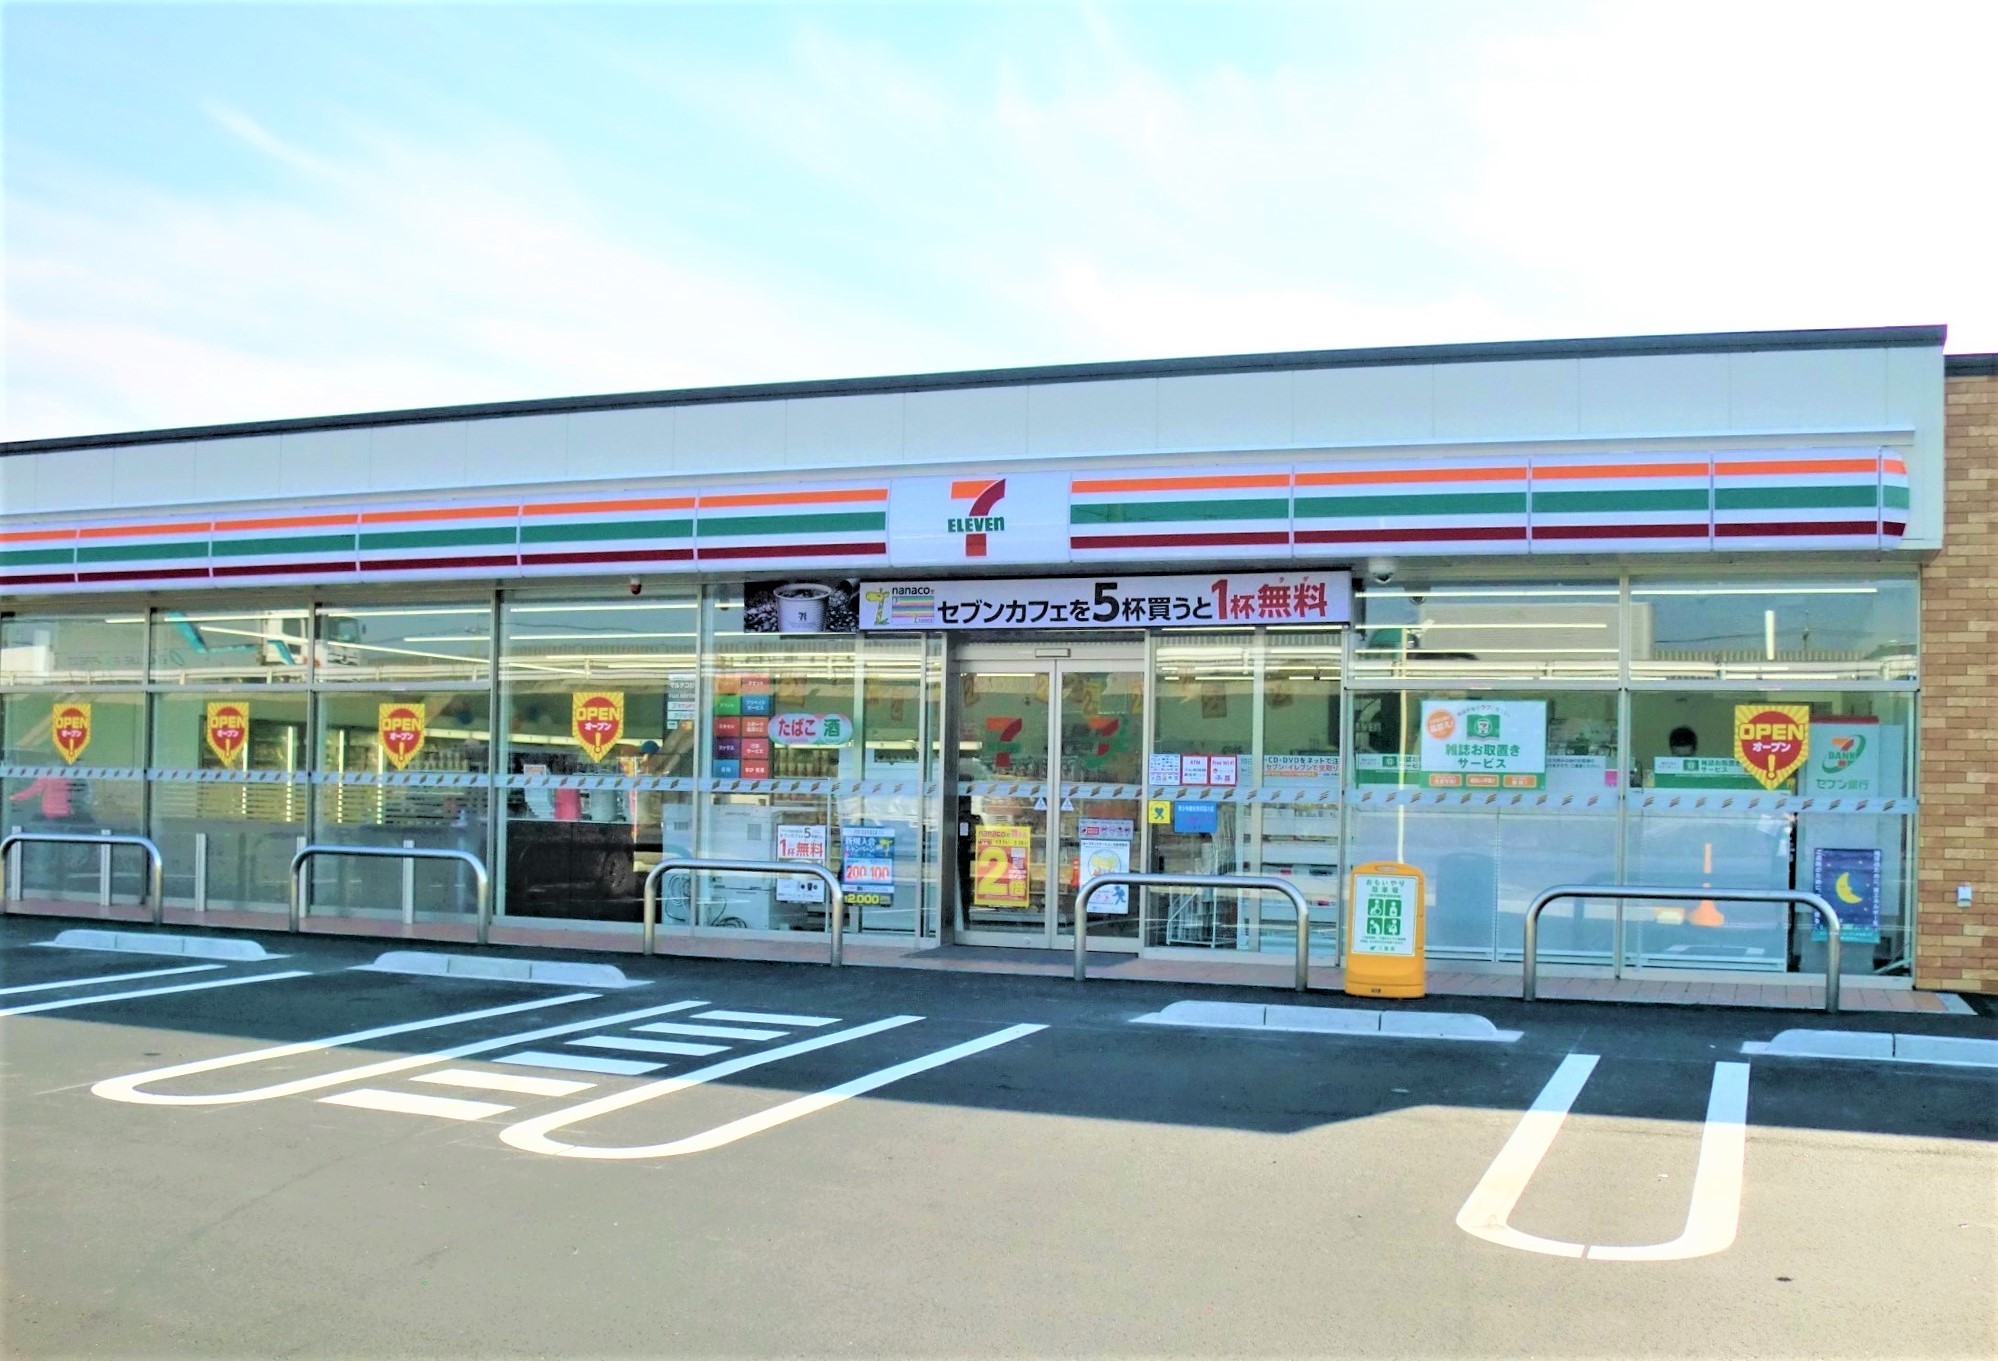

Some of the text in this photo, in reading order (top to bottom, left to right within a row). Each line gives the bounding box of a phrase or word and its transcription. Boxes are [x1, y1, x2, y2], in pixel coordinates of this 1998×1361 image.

[575, 707, 620, 721] OPEN
[210, 717, 245, 728] OPEN
[381, 717, 421, 731] OPEN
[585, 722, 611, 731] オープン
[778, 719, 841, 737] たばこ 酒
[389, 732, 414, 740] オープン
[1738, 723, 1805, 741] OPEN
[1445, 744, 1520, 757] 雑誌お取置き
[1752, 742, 1791, 752] オープン
[1458, 758, 1506, 768] サービス
[1816, 779, 1869, 790] セブン銀行
